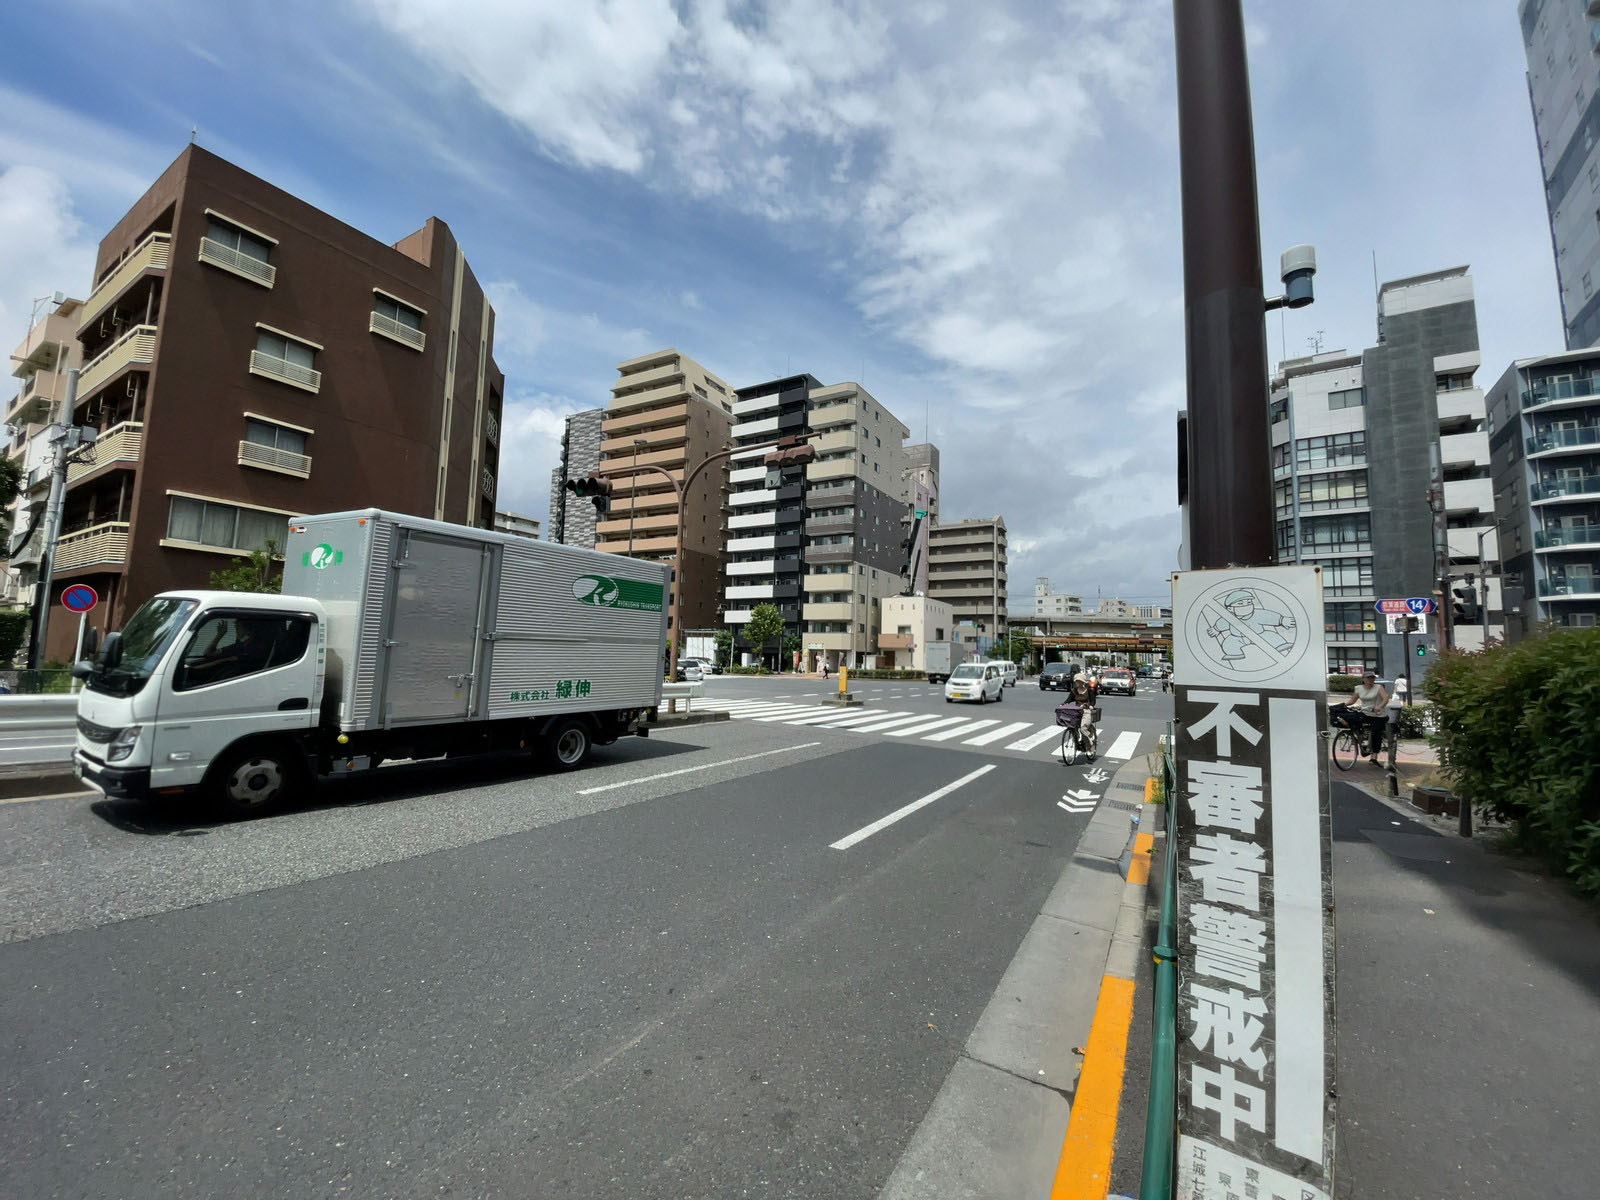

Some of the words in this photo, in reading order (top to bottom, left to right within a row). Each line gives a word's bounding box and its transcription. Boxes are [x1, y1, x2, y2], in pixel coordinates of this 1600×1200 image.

[1410, 599, 1424, 610] 14
[510, 690, 550, 701] 株式会社
[555, 679, 591, 699] 緑伸
[1186, 690, 1269, 1142] 不審者警戒中
